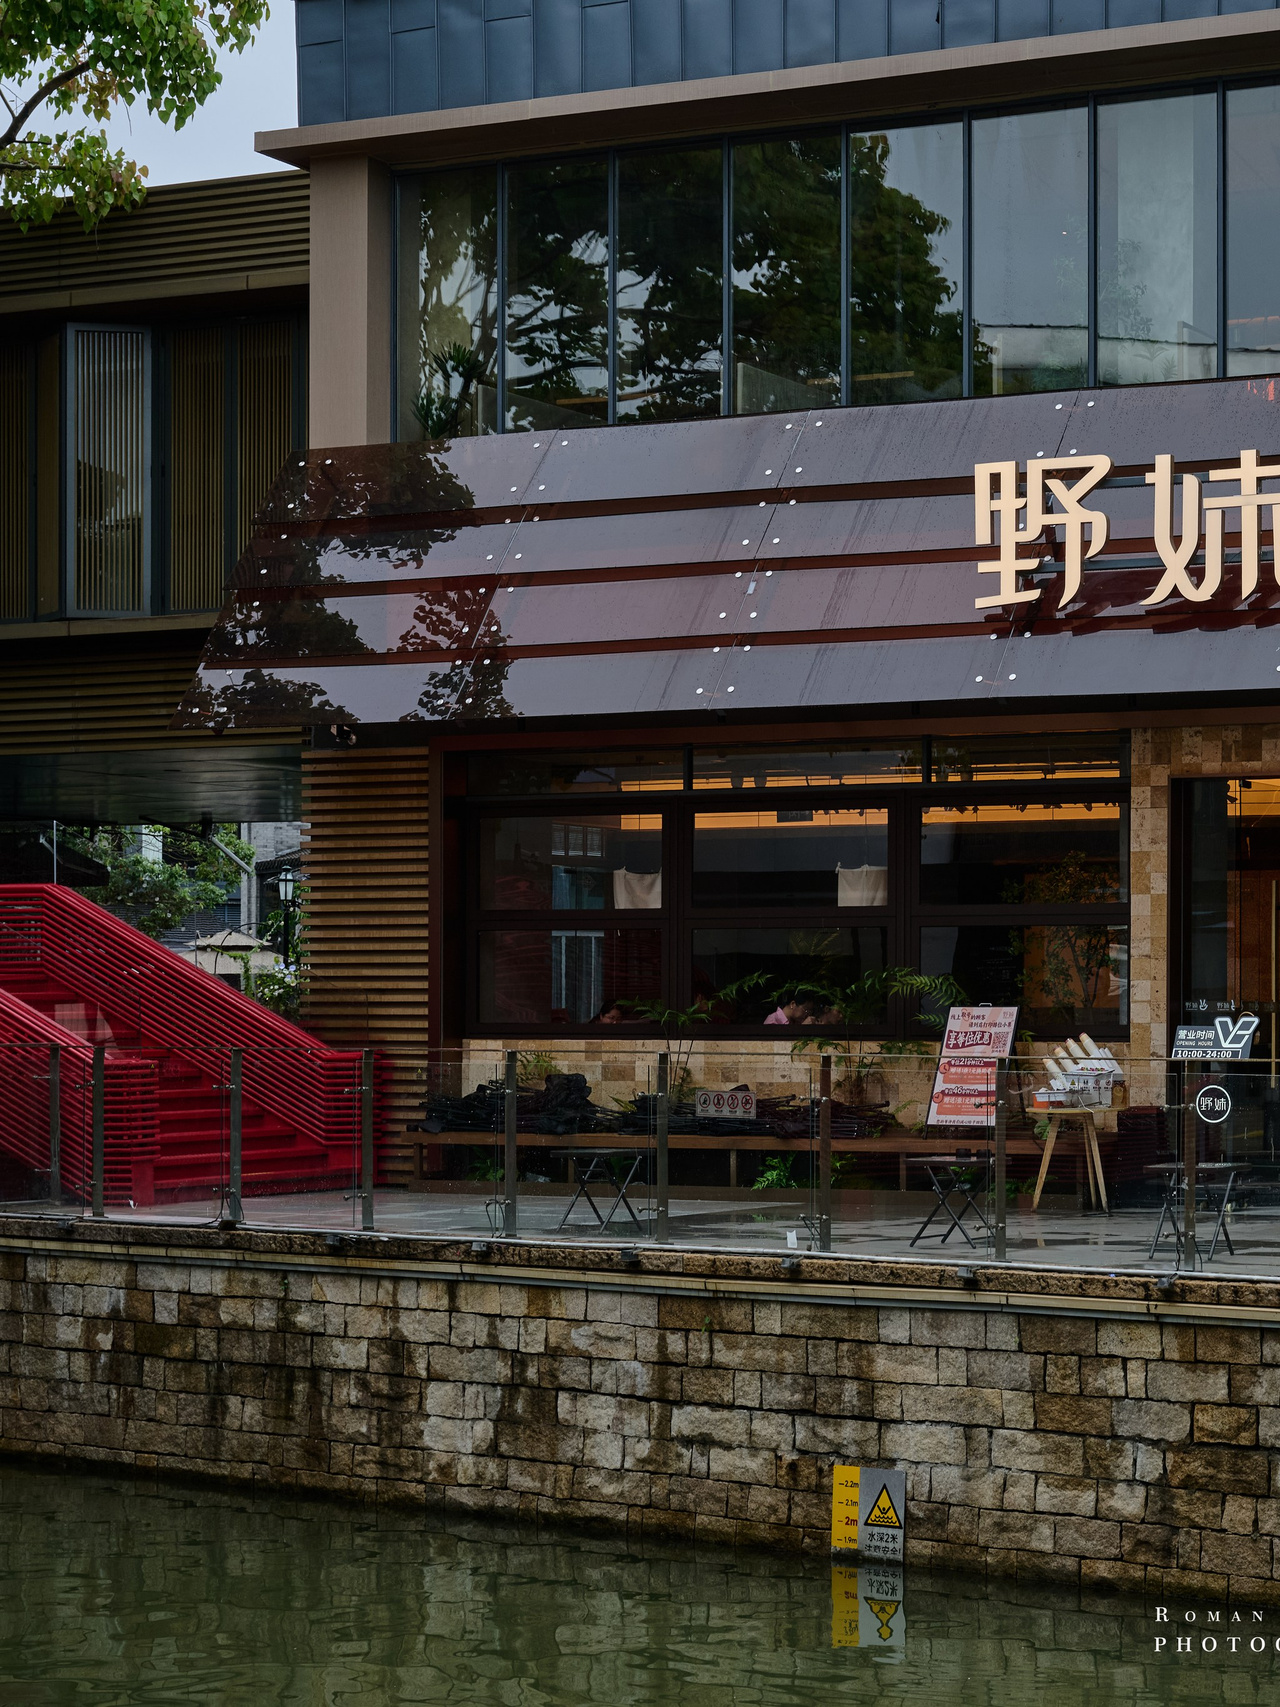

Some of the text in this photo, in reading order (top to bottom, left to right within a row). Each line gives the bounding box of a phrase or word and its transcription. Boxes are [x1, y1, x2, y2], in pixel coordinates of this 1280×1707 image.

[948, 1031, 990, 1048] 享等位优惠
[1178, 1030, 1215, 1040] 营业时间
[1177, 1050, 1232, 1058] 10:00-24:00
[1200, 1097, 1227, 1111] 野妹
[844, 1480, 859, 1488] 2.2m
[845, 1499, 858, 1507] 2.1m
[845, 1516, 858, 1526] 2m
[844, 1536, 857, 1544] 1.9m
[868, 1531, 898, 1544] 水深2米
